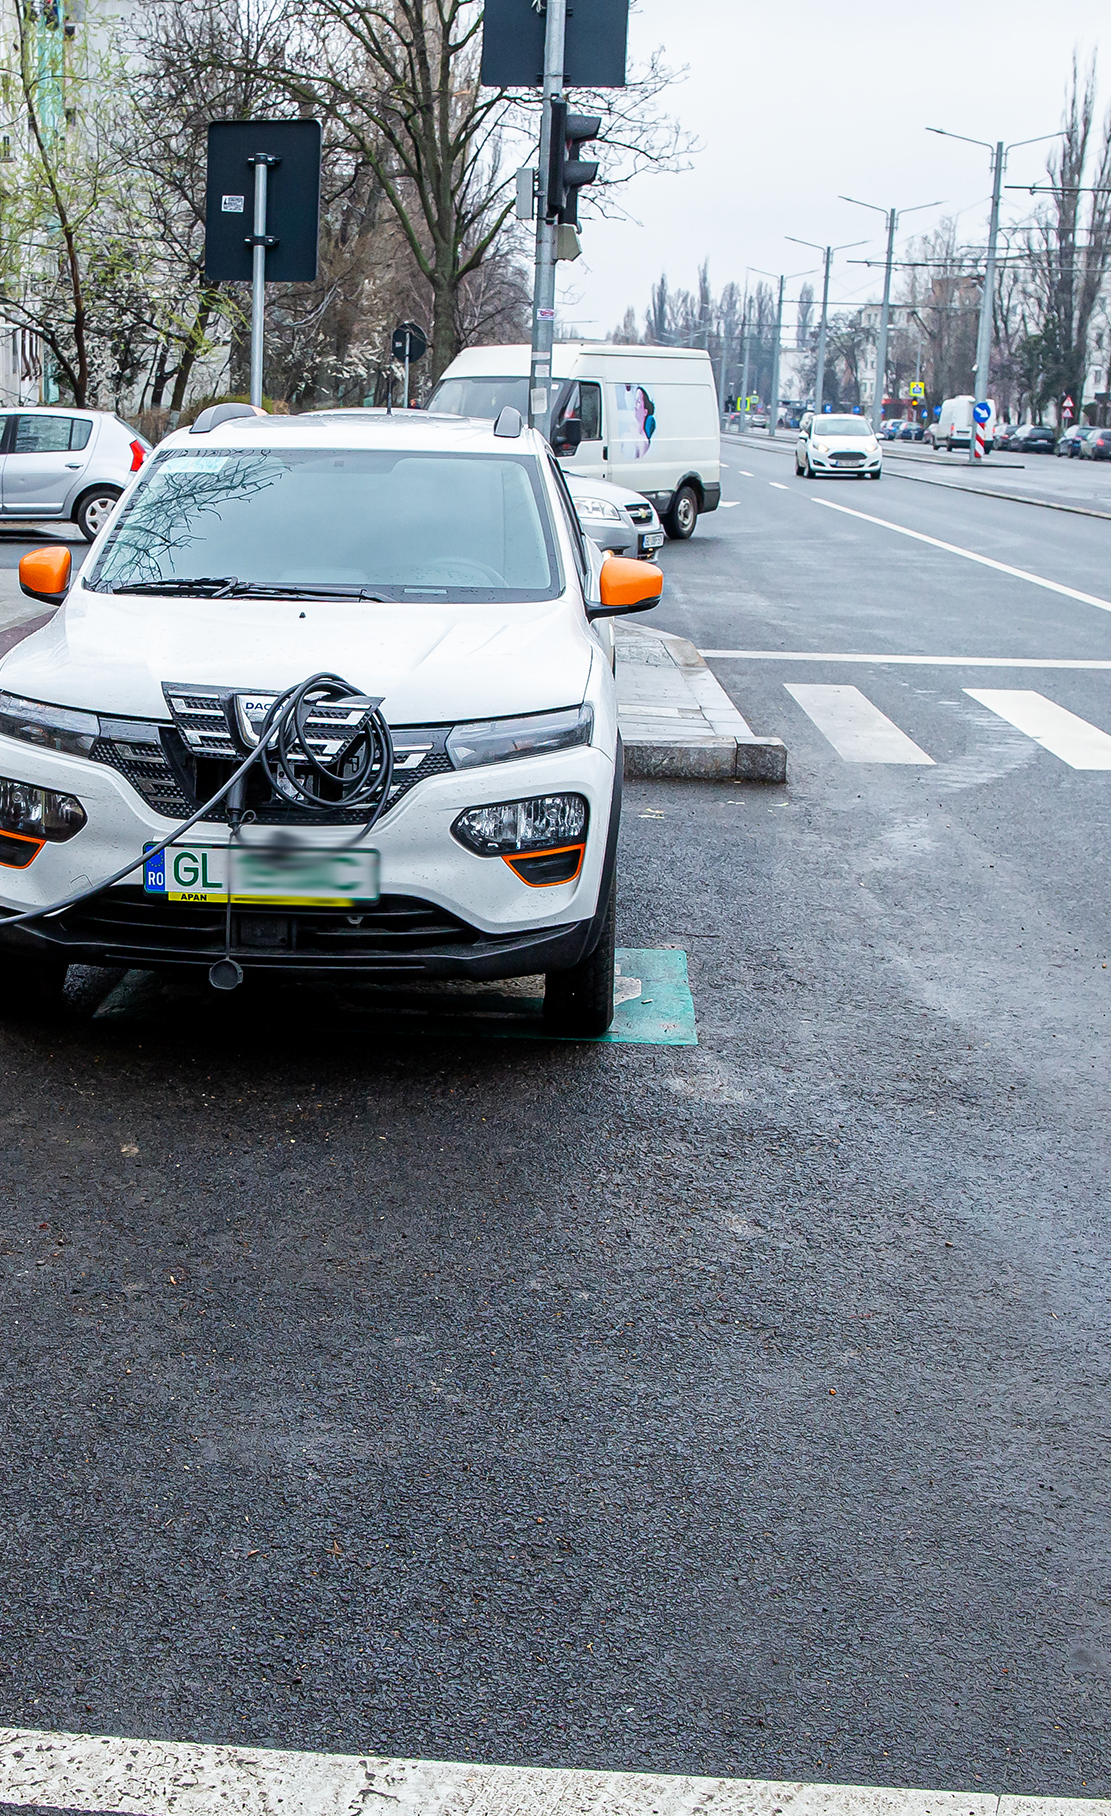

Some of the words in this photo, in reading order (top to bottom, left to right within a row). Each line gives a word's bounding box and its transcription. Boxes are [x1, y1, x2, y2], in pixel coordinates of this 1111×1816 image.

[173, 851, 223, 888] GL
[148, 871, 164, 886] RO
[180, 893, 207, 901] APAN
